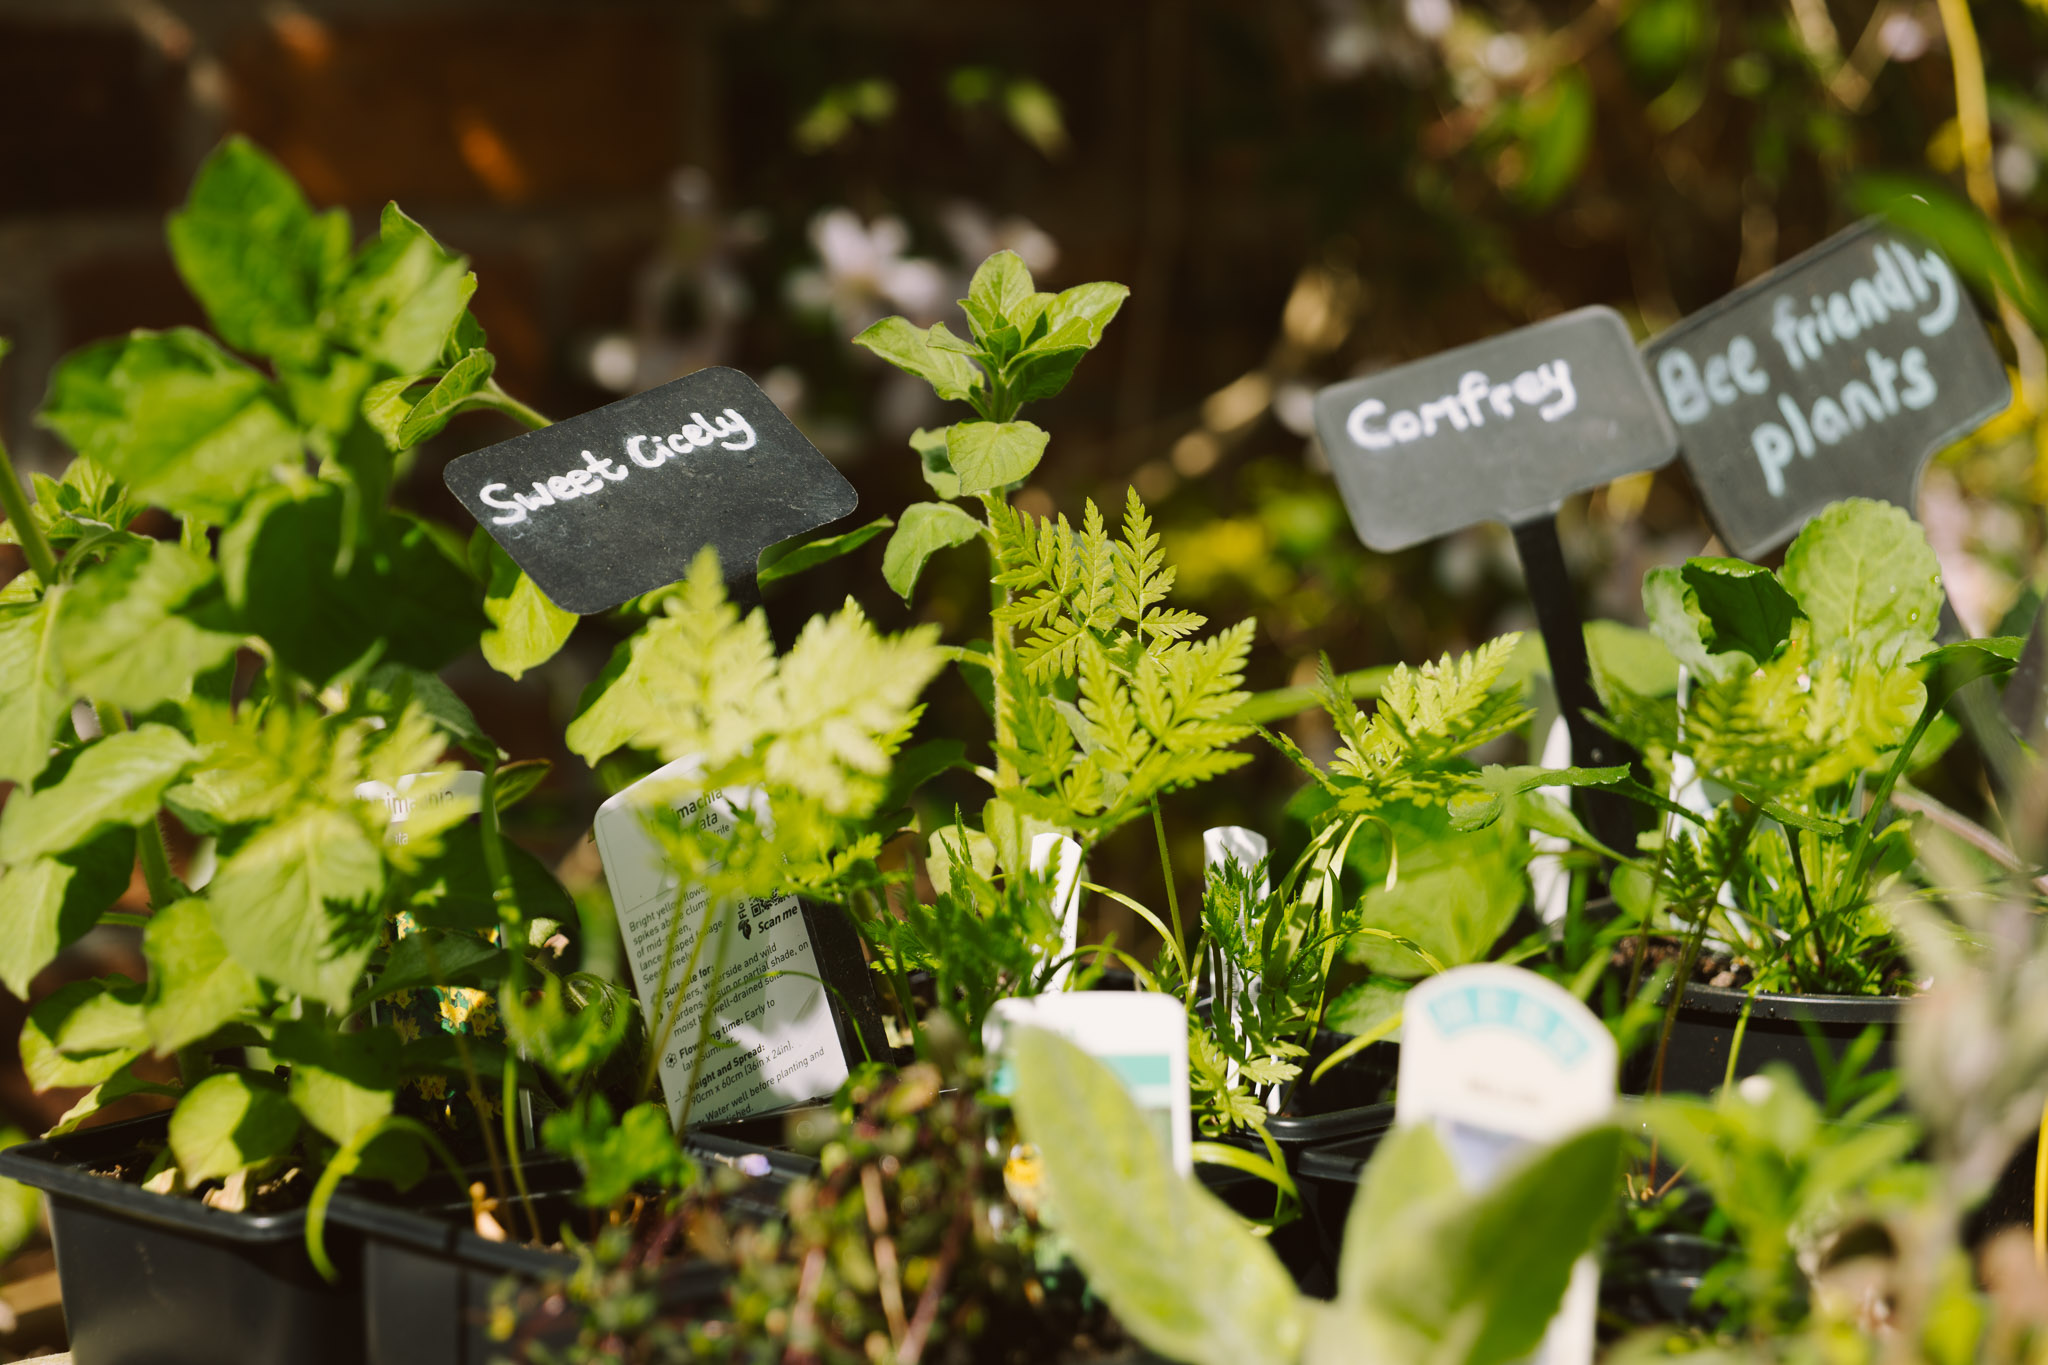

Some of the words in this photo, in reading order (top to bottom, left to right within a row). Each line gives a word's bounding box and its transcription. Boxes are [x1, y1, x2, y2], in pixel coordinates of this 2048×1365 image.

[1656, 335, 1770, 425] Bee
[1771, 239, 1960, 373] friendly
[1347, 358, 1577, 451] Comfrey
[1751, 346, 1938, 498] plants
[480, 450, 628, 525] Sweet
[627, 408, 757, 468] Cicely
[628, 911, 655, 933] Bright
[633, 925, 659, 945] spikes
[661, 912, 683, 930] aboe
[758, 914, 781, 934] Scan
[782, 905, 798, 921] me
[637, 946, 645, 958] of
[744, 953, 759, 968] and
[760, 942, 777, 959] wild
[771, 947, 797, 967] shade,
[799, 941, 809, 952] on
[664, 974, 698, 998] Suitle
[674, 1019, 697, 1038] moist
[722, 1018, 744, 1034] time:
[744, 1004, 765, 1022] Early
[767, 999, 775, 1009] to
[717, 1061, 732, 1077] and
[733, 1043, 765, 1067] Spread:
[705, 1103, 730, 1121] Water
[731, 1090, 749, 1108] well
[749, 1077, 775, 1097] before
[776, 1057, 809, 1084] planting
[810, 1046, 825, 1062] and
[721, 1071, 744, 1089] 60cm
